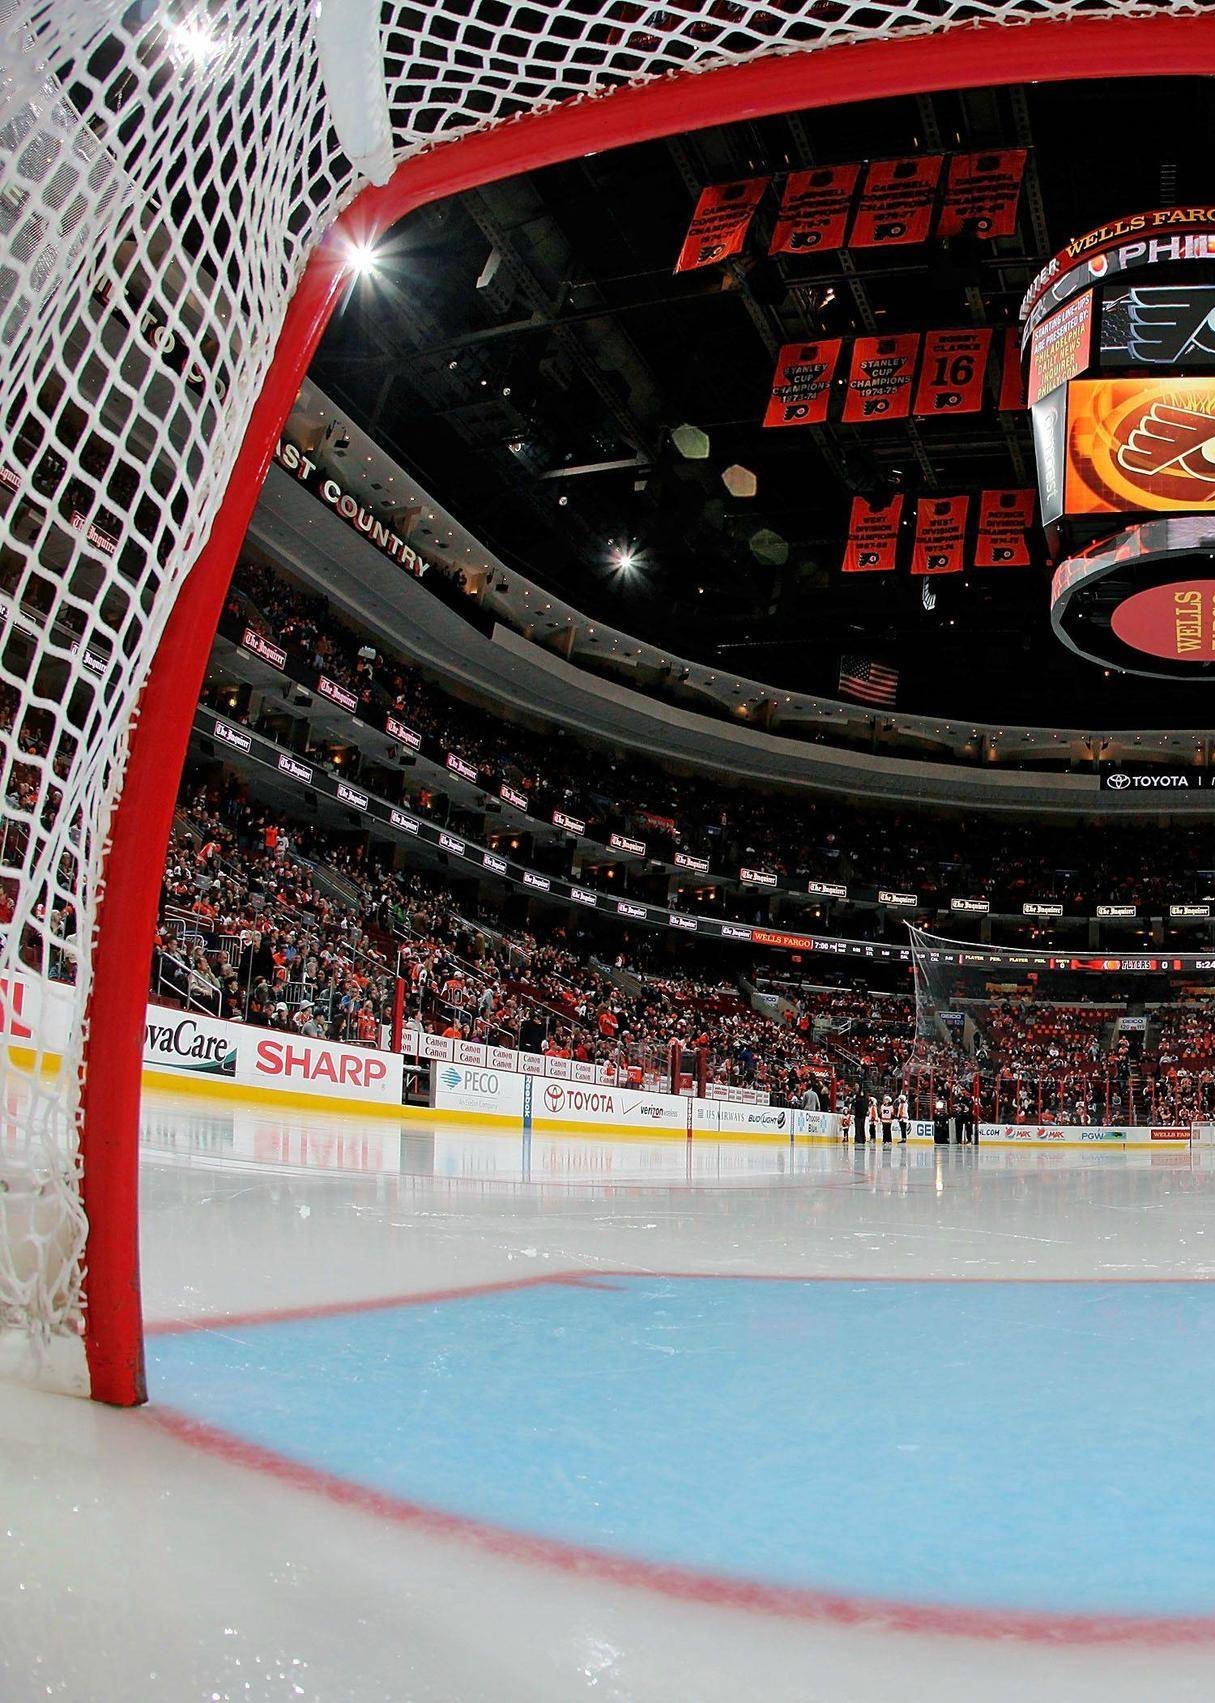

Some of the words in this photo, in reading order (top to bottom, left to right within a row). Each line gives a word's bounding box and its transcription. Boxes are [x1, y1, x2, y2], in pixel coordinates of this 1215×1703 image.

[1066, 216, 1145, 257] WELLS
[1035, 311, 1061, 340] STARTING
[1035, 339, 1045, 352] ARE
[1045, 320, 1078, 346] PRESENTED
[1078, 310, 1089, 325] BY:
[1035, 324, 1085, 366] PHILADELPHIA
[1038, 353, 1056, 373] DAILY
[1058, 339, 1081, 363] NEWS
[784, 364, 828, 375] STANLEY
[860, 358, 907, 369] STANLEY
[872, 368, 892, 377] CUP
[930, 356, 976, 386] 16
[1041, 355, 1075, 385] INQUIRER
[794, 374, 814, 383] CUP
[850, 376, 912, 388] CHAMPIONS
[772, 382, 831, 395] CHAMPIONS
[861, 386, 897, 397] 1974-75
[320, 479, 430, 577] COUNTRY
[1176, 590, 1201, 653] WELLS
[245, 632, 260, 650] The
[257, 638, 285, 666] Inquirer
[320, 679, 333, 696] The
[331, 685, 356, 710] Inquirer
[216, 723, 228, 738] The
[227, 729, 250, 750] Inquirer
[388, 720, 400, 735] The
[398, 725, 420, 747] Inquirer
[1132, 776, 1188, 787] TOYOTA
[755, 932, 782, 944] WELLS
[784, 937, 811, 948] FARGO
[815, 942, 828, 950] 7:00
[1121, 960, 1150, 970] FLYERS
[1162, 961, 1168, 969] 0
[425, 1036, 448, 1048] Canon
[460, 1042, 480, 1053] Canon
[425, 1047, 447, 1058] Canon
[460, 1052, 480, 1064] Canon
[492, 1048, 512, 1059] Canon
[523, 1054, 540, 1063] Canon
[255, 1040, 387, 1088] SHARP
[492, 1058, 512, 1069] Canon
[464, 1071, 498, 1094] PECO
[567, 1091, 614, 1113] TOYOTA
[640, 1104, 663, 1118] verizon
[748, 1115, 761, 1123] BUD
[1081, 1132, 1104, 1140] PGW
